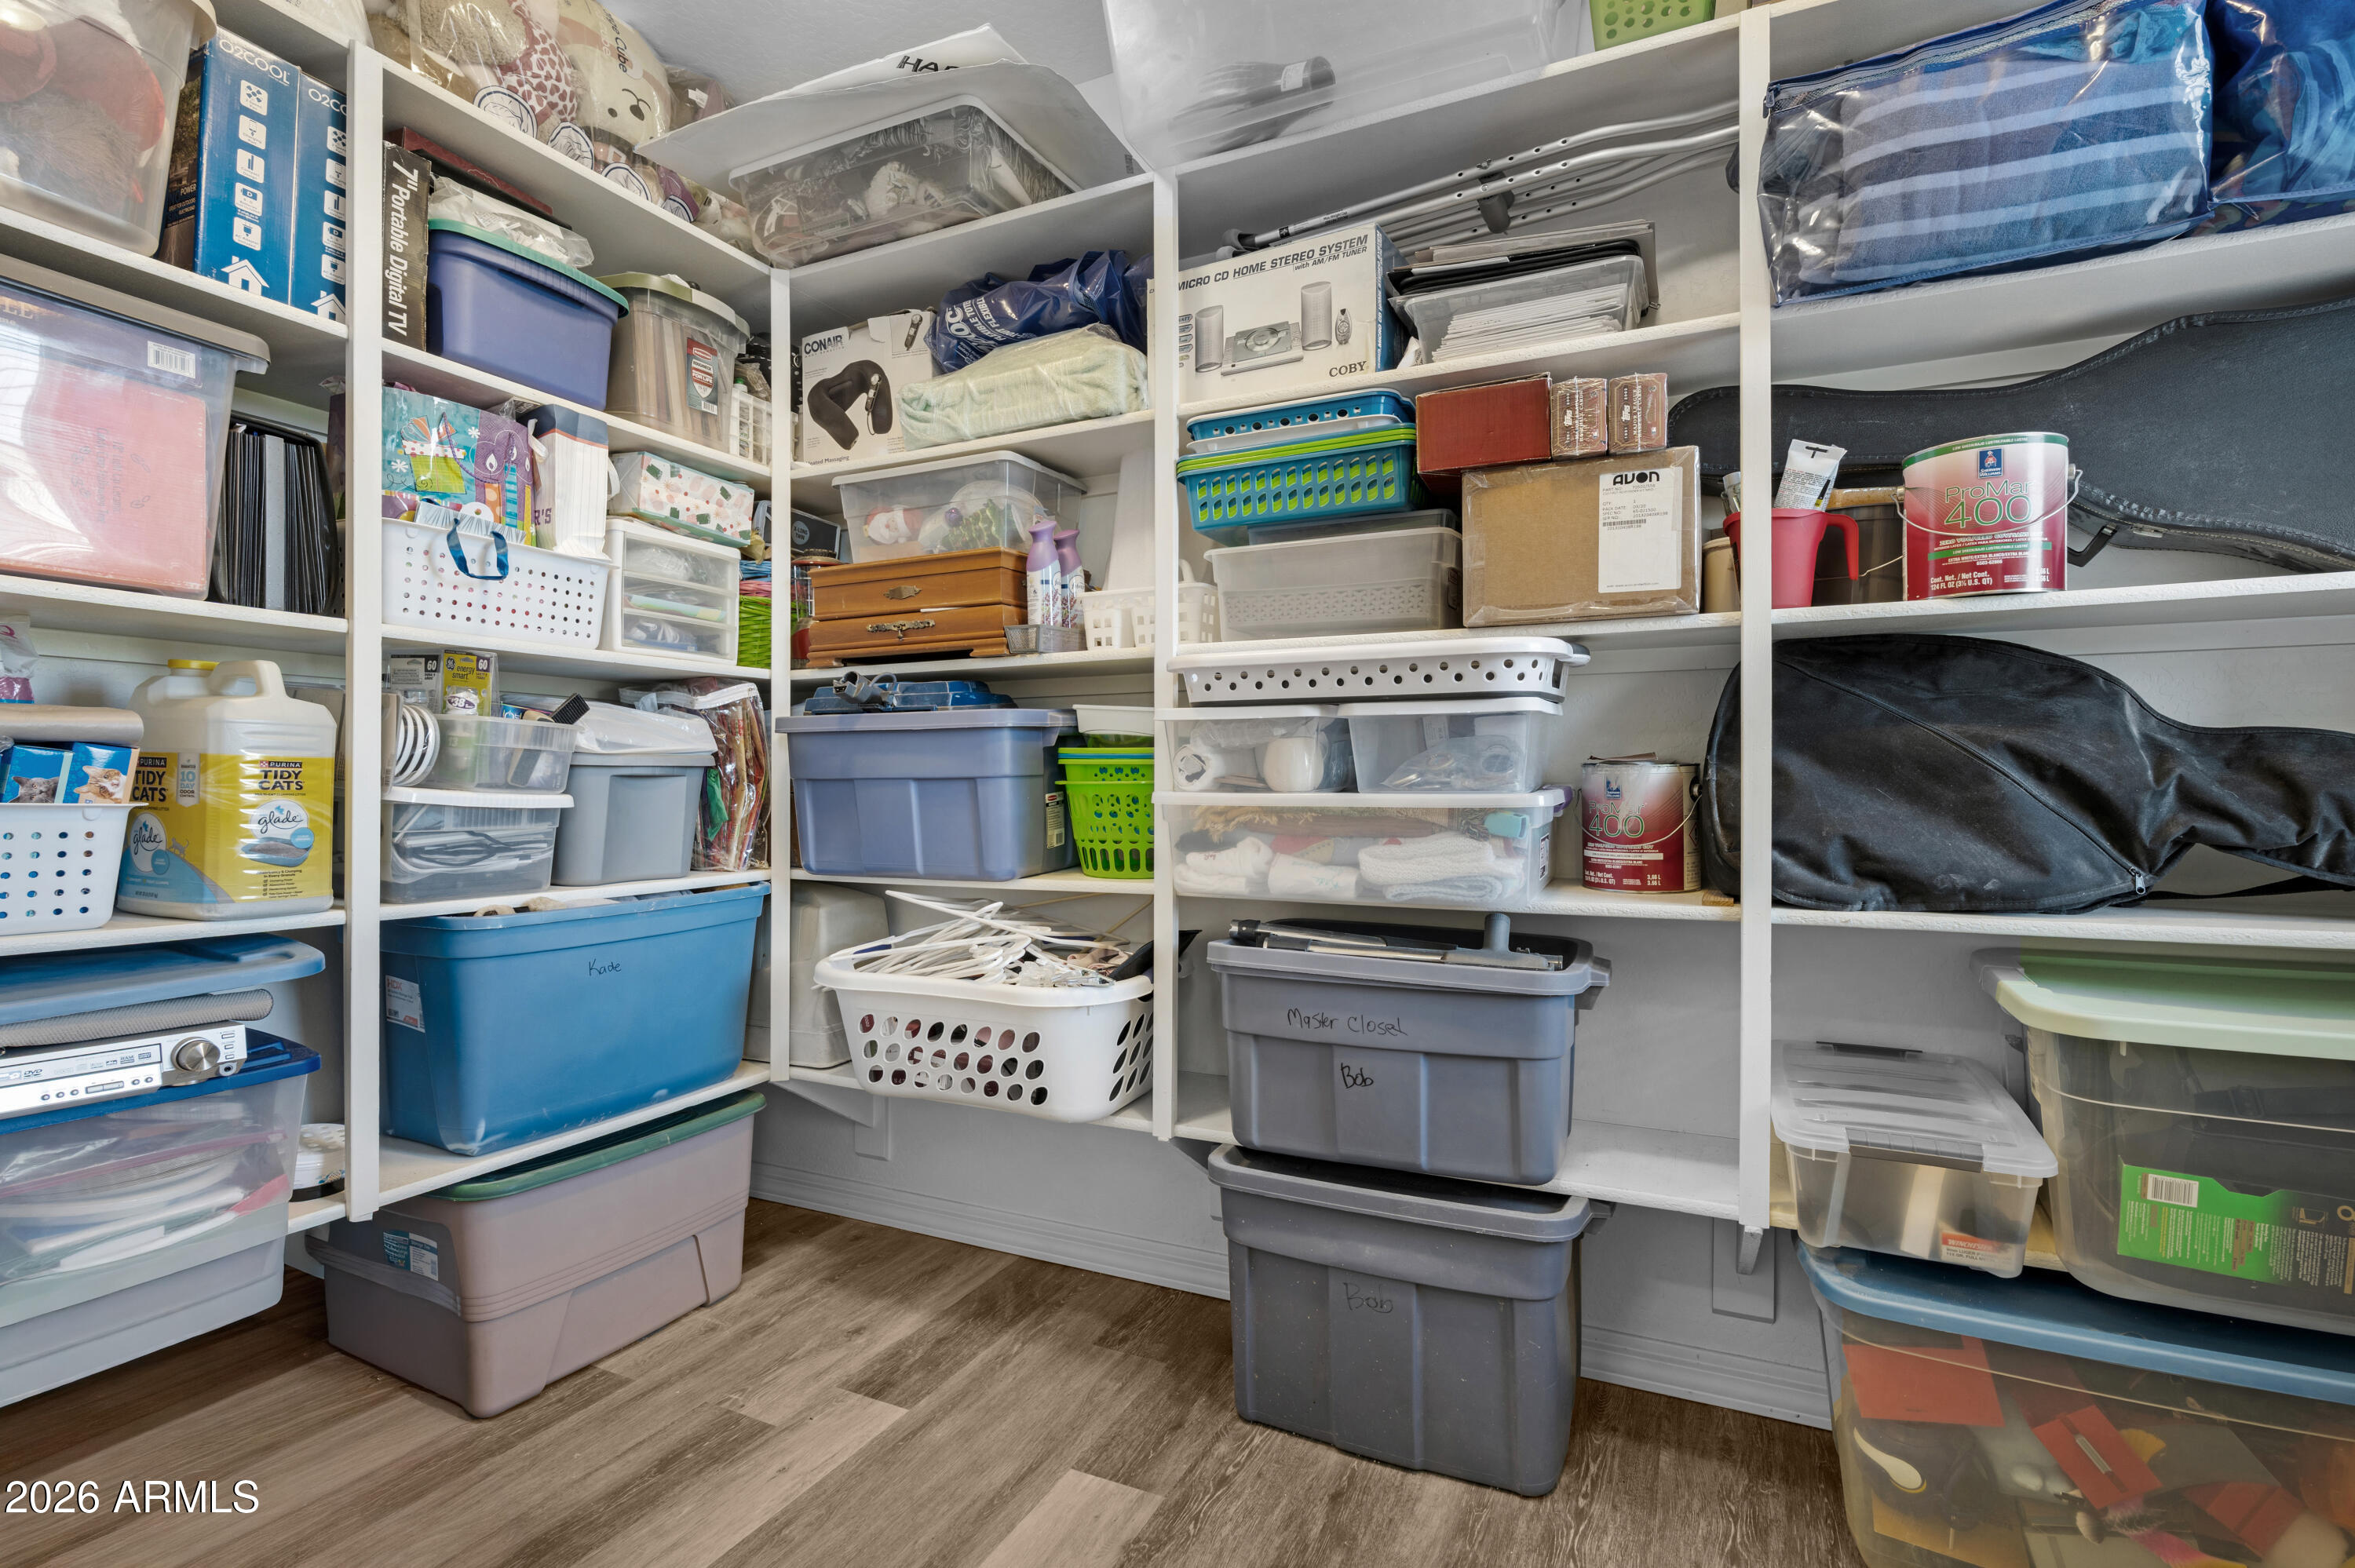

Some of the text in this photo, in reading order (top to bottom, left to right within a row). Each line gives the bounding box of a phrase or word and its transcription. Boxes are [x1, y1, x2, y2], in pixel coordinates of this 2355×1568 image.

[220, 40, 290, 85] O2COOL
[896, 56, 958, 72] HA
[384, 161, 419, 337] 7" Portable Digital TV
[1214, 271, 1229, 283] CD
[1232, 261, 1266, 278] HOME
[1270, 249, 1315, 268] STEREO
[1318, 234, 1369, 256] SYSTEM
[1294, 246, 1367, 272] with AM/FM TUNER
[804, 334, 843, 355] CONAIR
[1329, 361, 1367, 377] COBY
[824, 454, 849, 465] Massaging
[1945, 479, 2033, 503] ProMar
[1944, 494, 2032, 529] 400
[1982, 577, 1993, 585] QT)
[426, 659, 437, 671] 60
[456, 665, 475, 675] energy
[478, 658, 488, 670] 60
[451, 671, 469, 680] smart
[134, 771, 166, 786] TIDY
[181, 771, 195, 782] 10
[259, 769, 302, 779] TIDY
[258, 780, 303, 791] CATS
[132, 786, 166, 802] CATS
[258, 810, 304, 834] glade
[1589, 814, 1645, 838] 400
[133, 826, 163, 855] glade
[589, 958, 622, 976] Kade
[387, 976, 403, 992] HDX
[1287, 1008, 1338, 1030] Master
[1341, 1062, 1375, 1089] Bob
